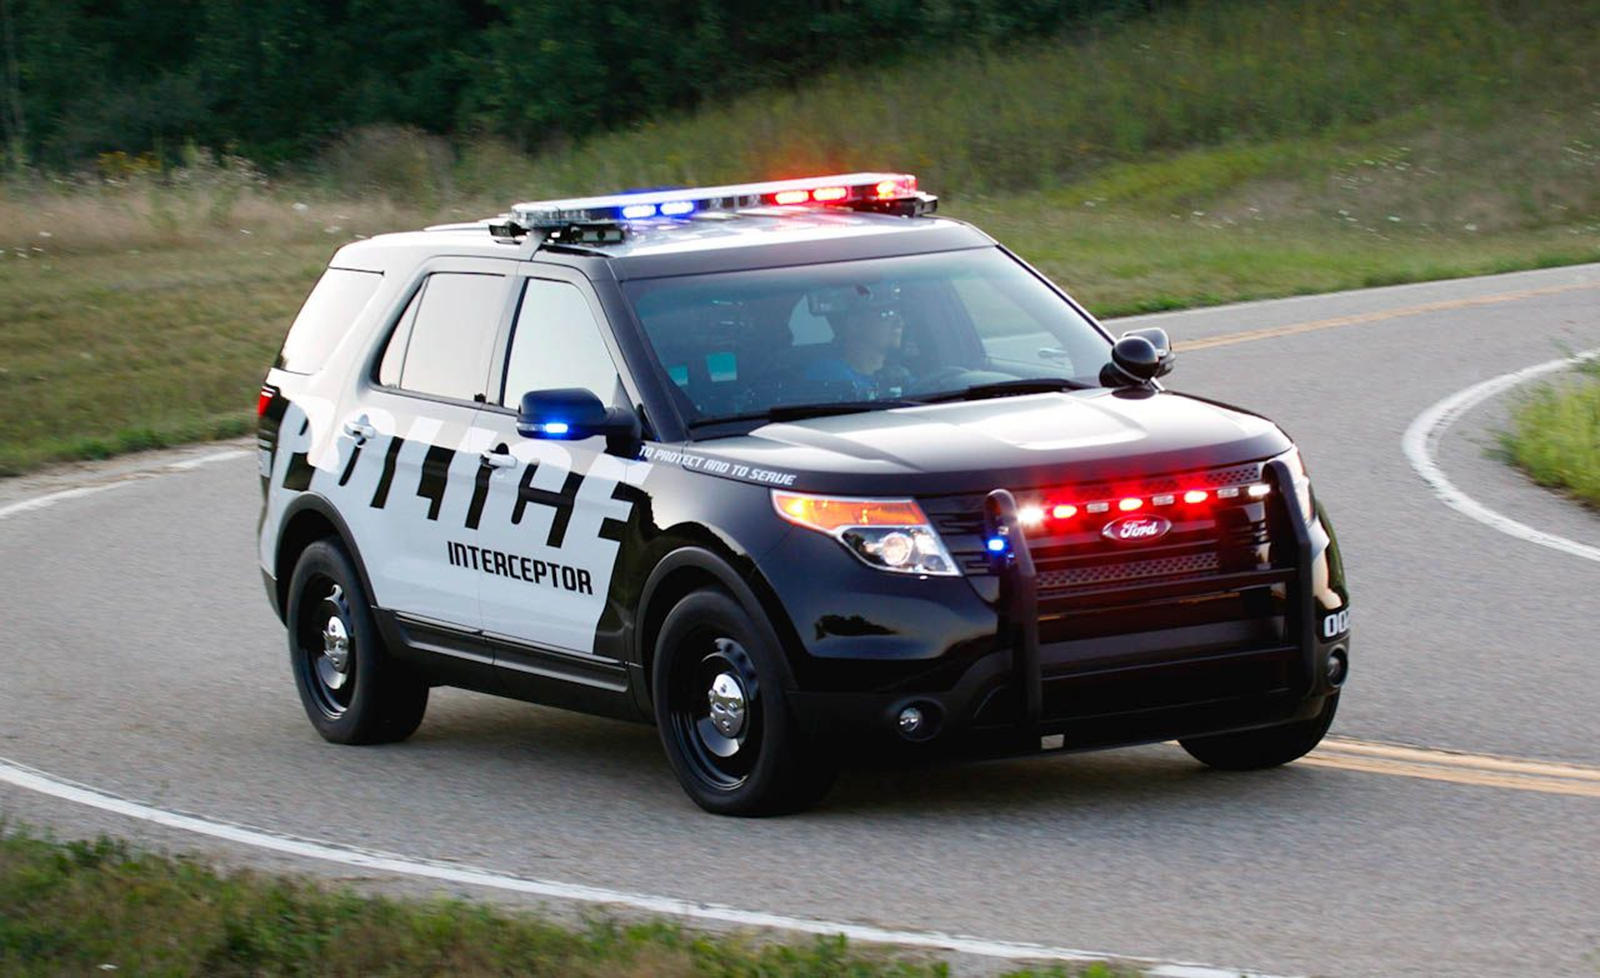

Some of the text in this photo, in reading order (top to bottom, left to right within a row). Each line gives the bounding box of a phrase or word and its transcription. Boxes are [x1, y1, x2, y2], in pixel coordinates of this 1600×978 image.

[268, 394, 655, 553] POLICE
[638, 445, 797, 485] TO PROTECT AND TO SERVE
[1120, 519, 1158, 538] Ford
[447, 541, 593, 595] INTERCEPTOR
[1323, 607, 1350, 637] 00
